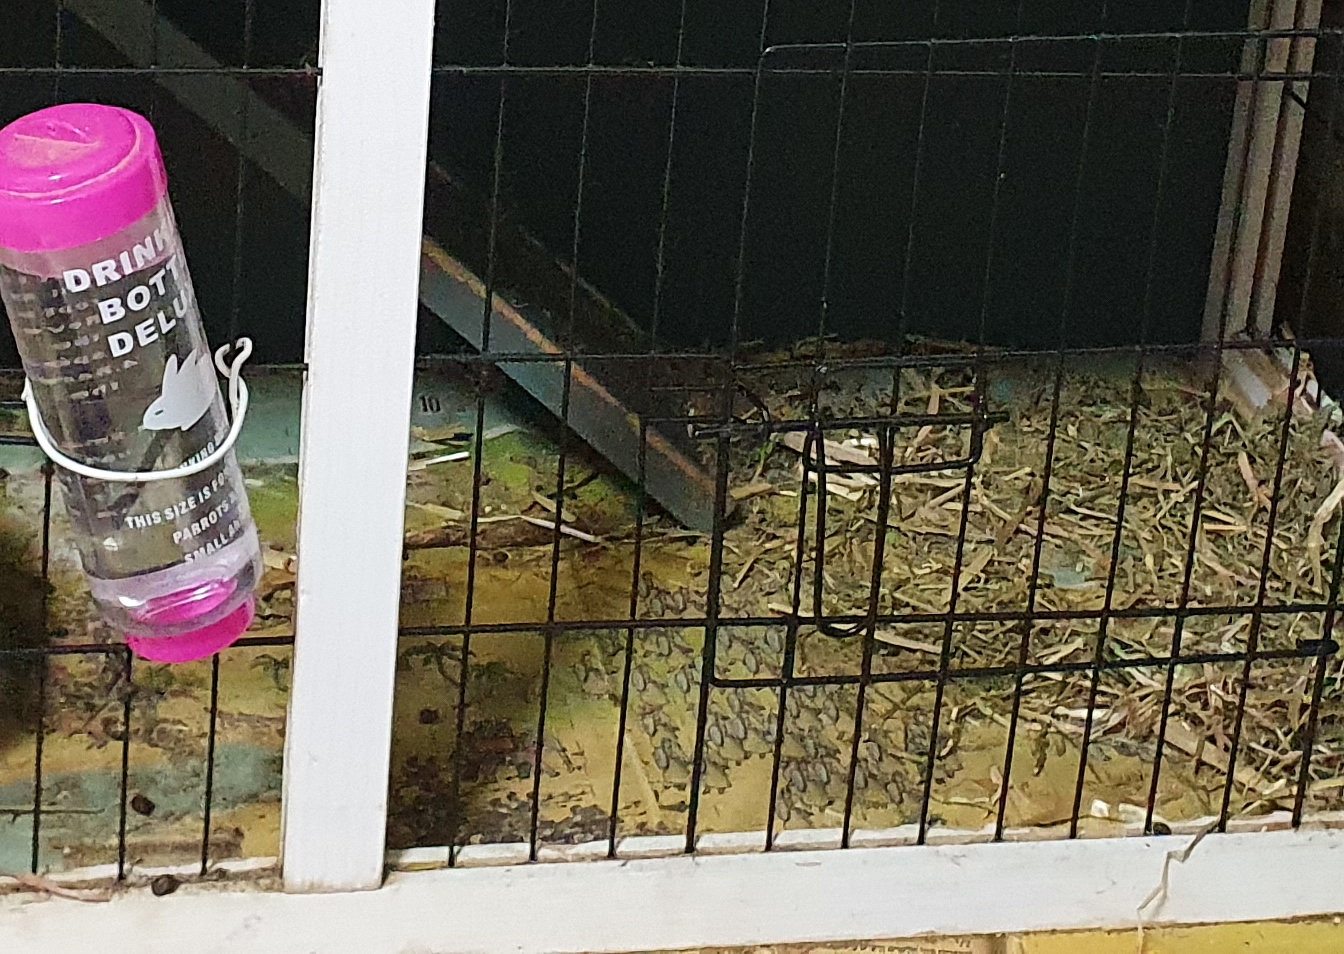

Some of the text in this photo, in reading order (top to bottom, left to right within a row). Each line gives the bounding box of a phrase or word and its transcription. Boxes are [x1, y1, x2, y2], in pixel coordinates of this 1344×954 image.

[124, 511, 162, 529] THIS
[164, 496, 197, 521] SIZE
[198, 485, 212, 504] IS
[172, 499, 229, 544] PARROTS
